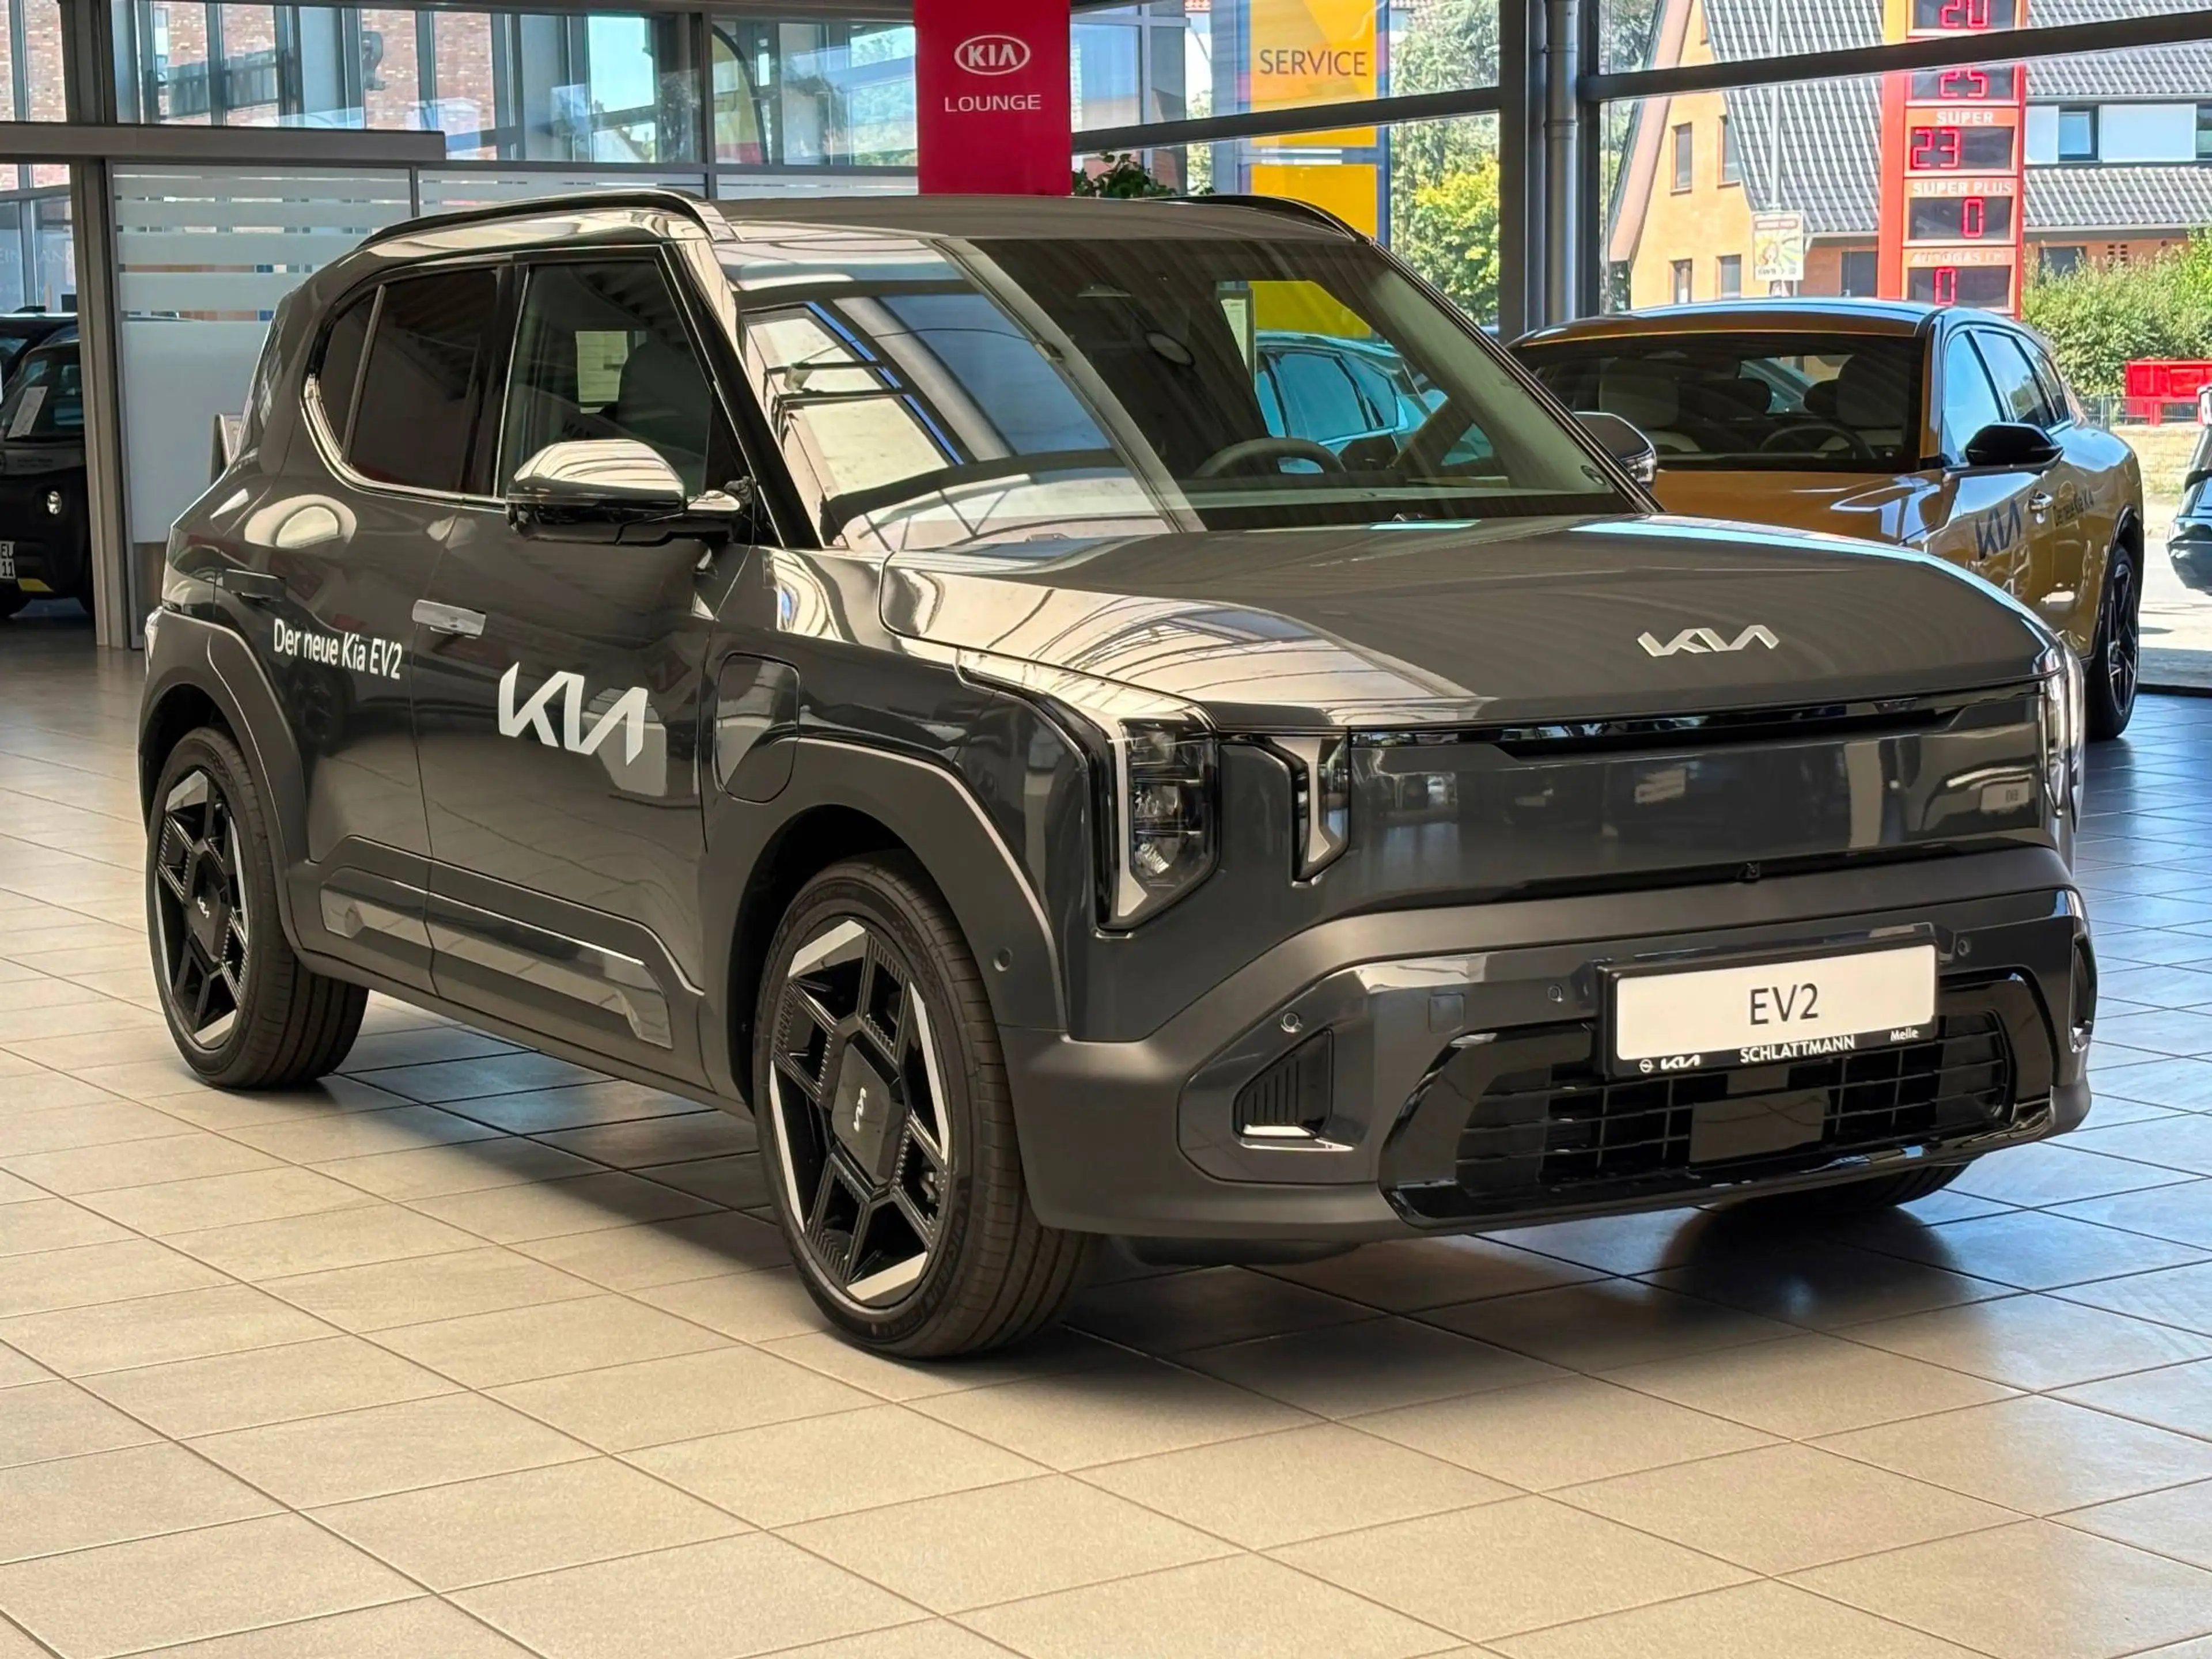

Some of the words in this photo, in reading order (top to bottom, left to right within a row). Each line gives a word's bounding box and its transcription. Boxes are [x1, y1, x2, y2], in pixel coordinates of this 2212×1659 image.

[967, 44, 1018, 67] KIA
[1259, 49, 1368, 77] SERVICE
[944, 94, 1041, 112] LOUNGE
[1936, 111, 1994, 124] SUPER
[1911, 128, 1959, 168] 23
[1913, 181, 1967, 194] SUPER
[1974, 181, 2012, 194] PLUS
[1963, 196, 1983, 238] 0
[274, 618, 301, 656] Der
[304, 632, 339, 666] neue
[342, 631, 366, 672] Kia
[369, 637, 403, 680] EV2
[1637, 624, 1780, 657] KIA
[498, 661, 649, 766] KIA
[1750, 982, 1819, 1026] EV2
[1660, 1054, 1701, 1070] KIA
[1740, 1035, 1855, 1063] SCHLATTMANN
[1890, 1027, 1919, 1042] Melle
